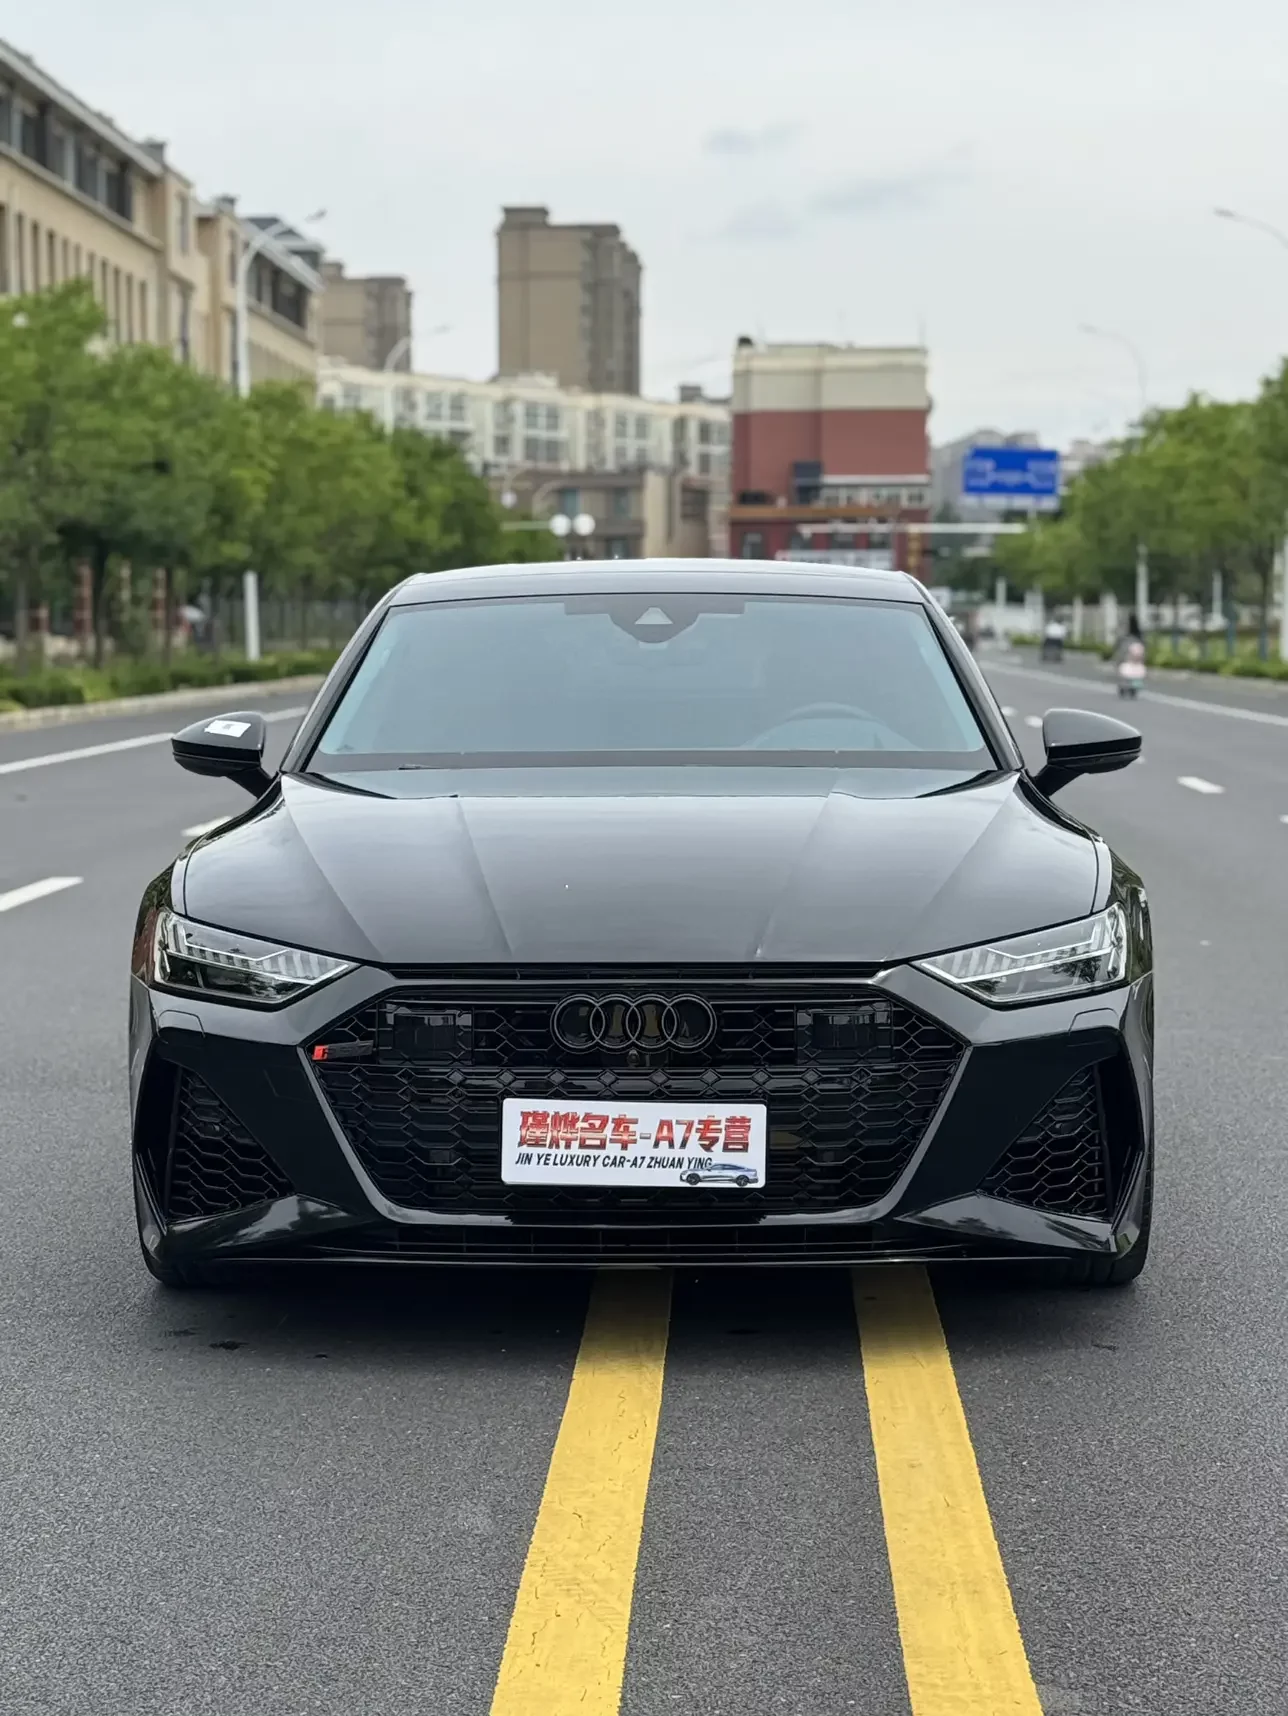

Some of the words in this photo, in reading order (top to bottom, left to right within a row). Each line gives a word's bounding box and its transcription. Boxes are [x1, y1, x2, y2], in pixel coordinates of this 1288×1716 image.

[515, 1153, 533, 1166] JIN
[536, 1153, 552, 1166] YE
[552, 1154, 601, 1168] LUXURY
[602, 1155, 646, 1169] CAR-A7
[646, 1156, 684, 1170] ZHUAN
[686, 1157, 713, 1171] YING
